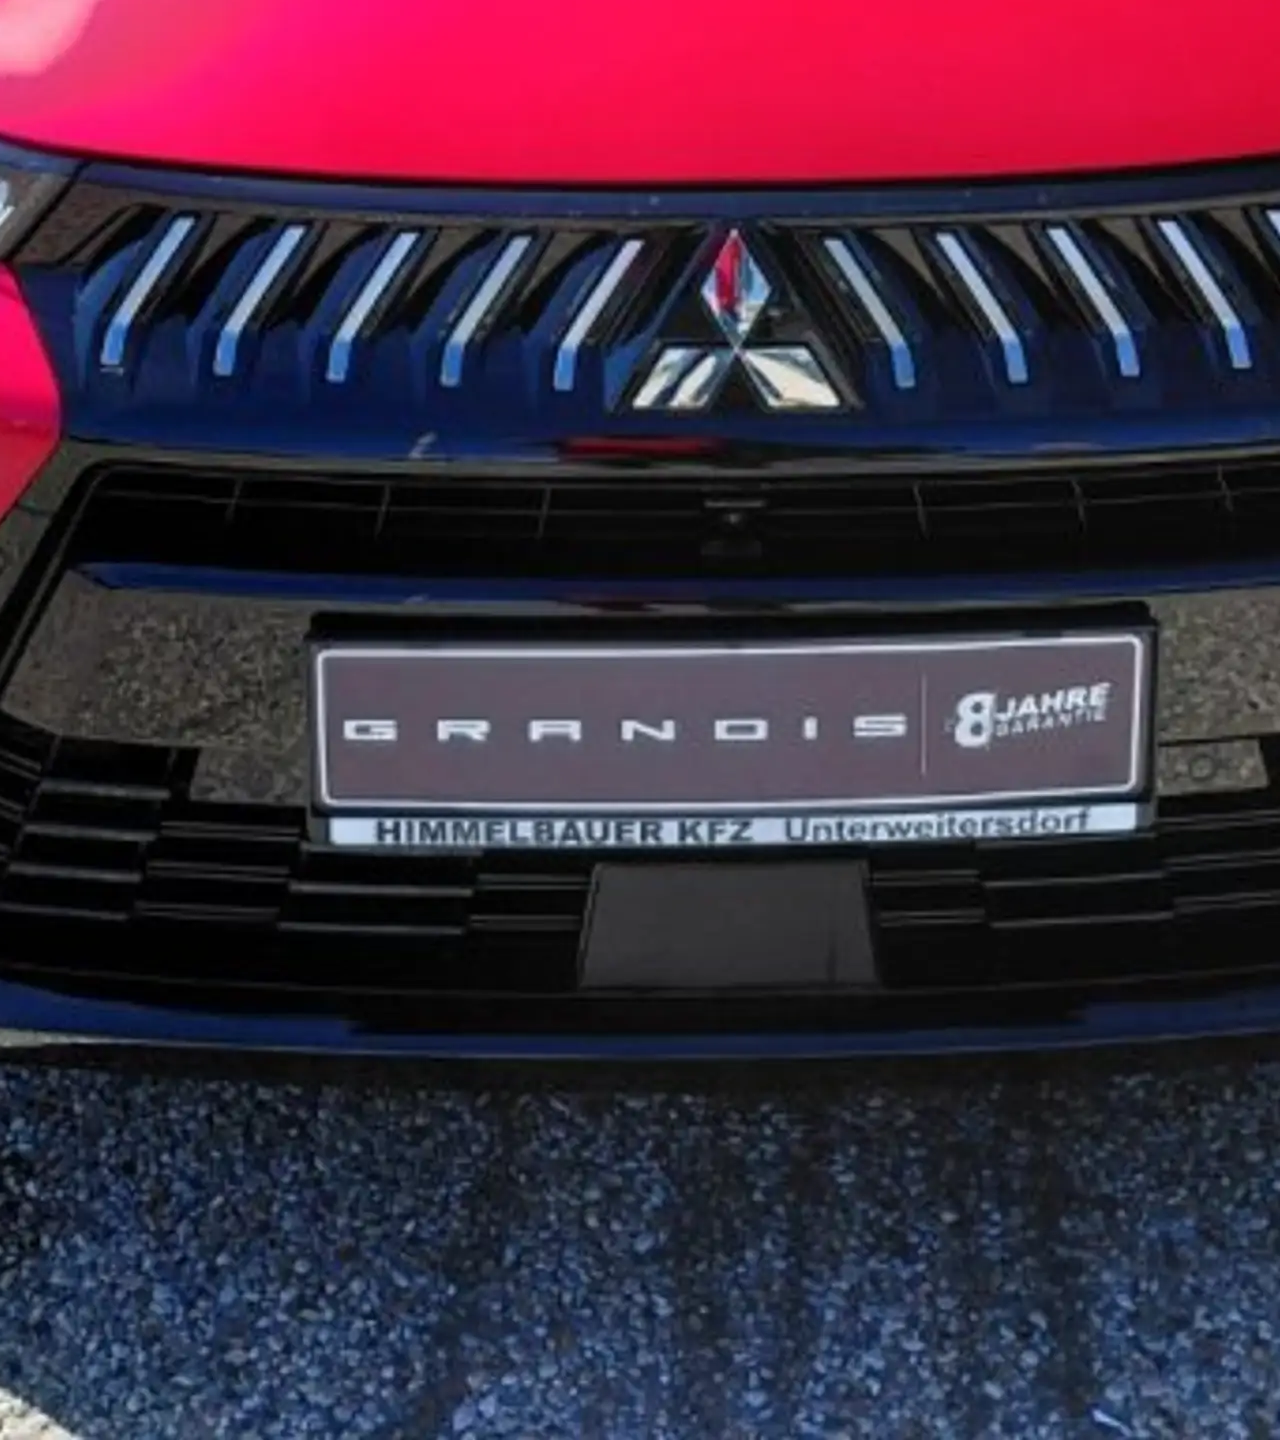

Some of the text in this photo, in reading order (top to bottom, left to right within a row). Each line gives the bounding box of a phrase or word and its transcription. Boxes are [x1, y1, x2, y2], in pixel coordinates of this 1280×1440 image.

[342, 713, 908, 742] GRANDIS
[954, 682, 1111, 748] 8 JAHRE
[374, 807, 1090, 844] HIMMELBAUER KFZ Unterweitersdorf
